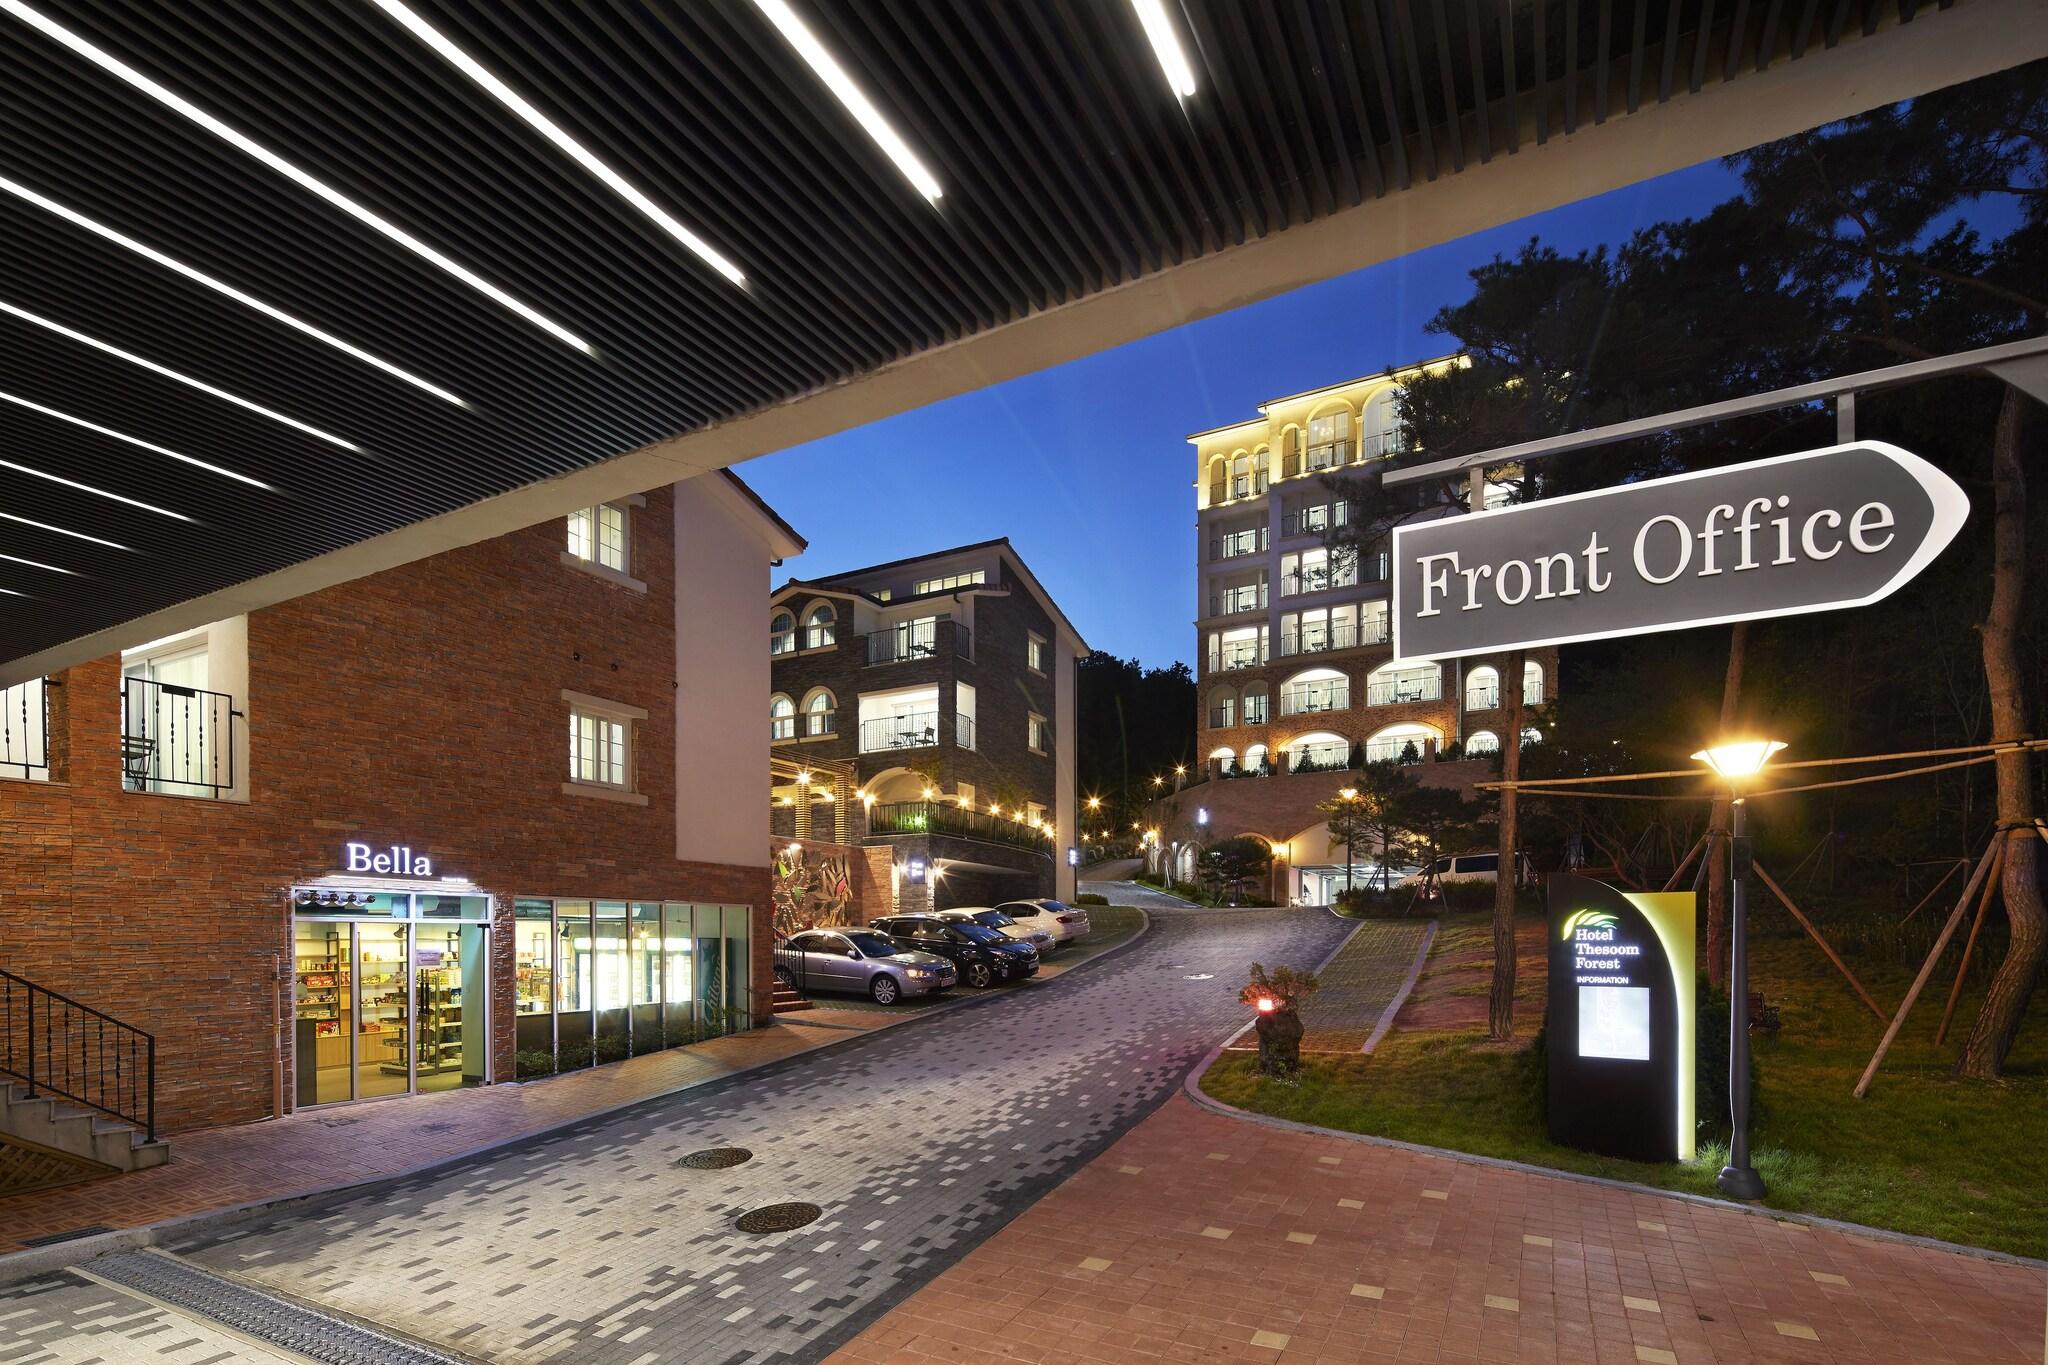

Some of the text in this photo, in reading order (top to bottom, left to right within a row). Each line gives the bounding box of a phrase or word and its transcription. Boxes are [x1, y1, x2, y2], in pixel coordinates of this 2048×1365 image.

[1416, 494, 1895, 617] Front Office
[346, 843, 432, 876] Bella
[1576, 929, 1614, 941] Hotel
[1576, 943, 1640, 955] Thesoom
[1576, 957, 1621, 969] Forest
[1577, 976, 1629, 984] INFORMATION
